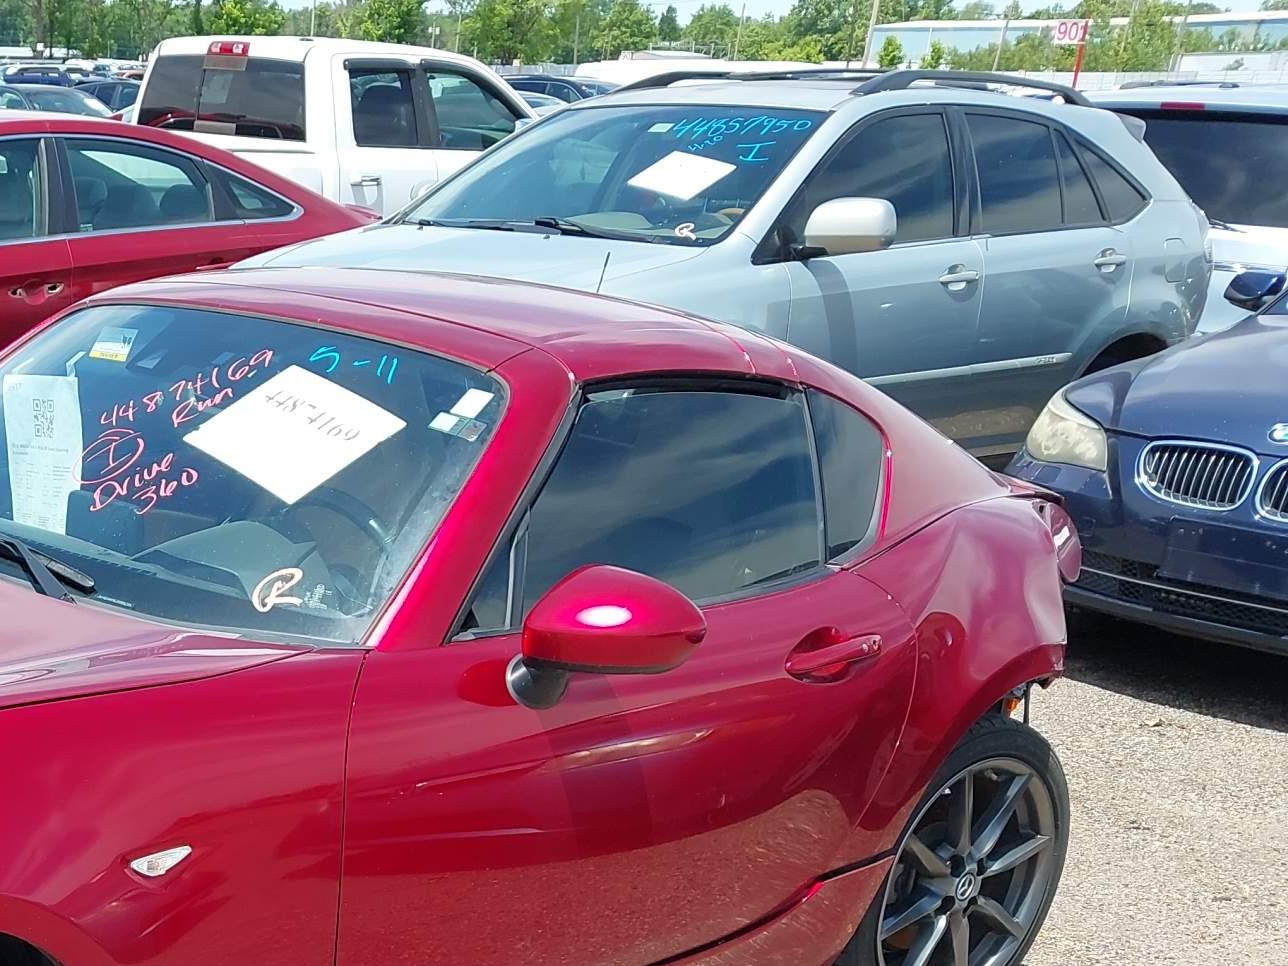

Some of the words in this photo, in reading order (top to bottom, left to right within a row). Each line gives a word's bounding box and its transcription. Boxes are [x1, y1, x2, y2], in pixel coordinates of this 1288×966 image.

[673, 115, 812, 140] 44857950
[309, 346, 398, 384] 5-11
[100, 349, 273, 426] 44874169
[171, 387, 234, 428] Run
[89, 453, 174, 512] Drive
[132, 467, 199, 515] 360
